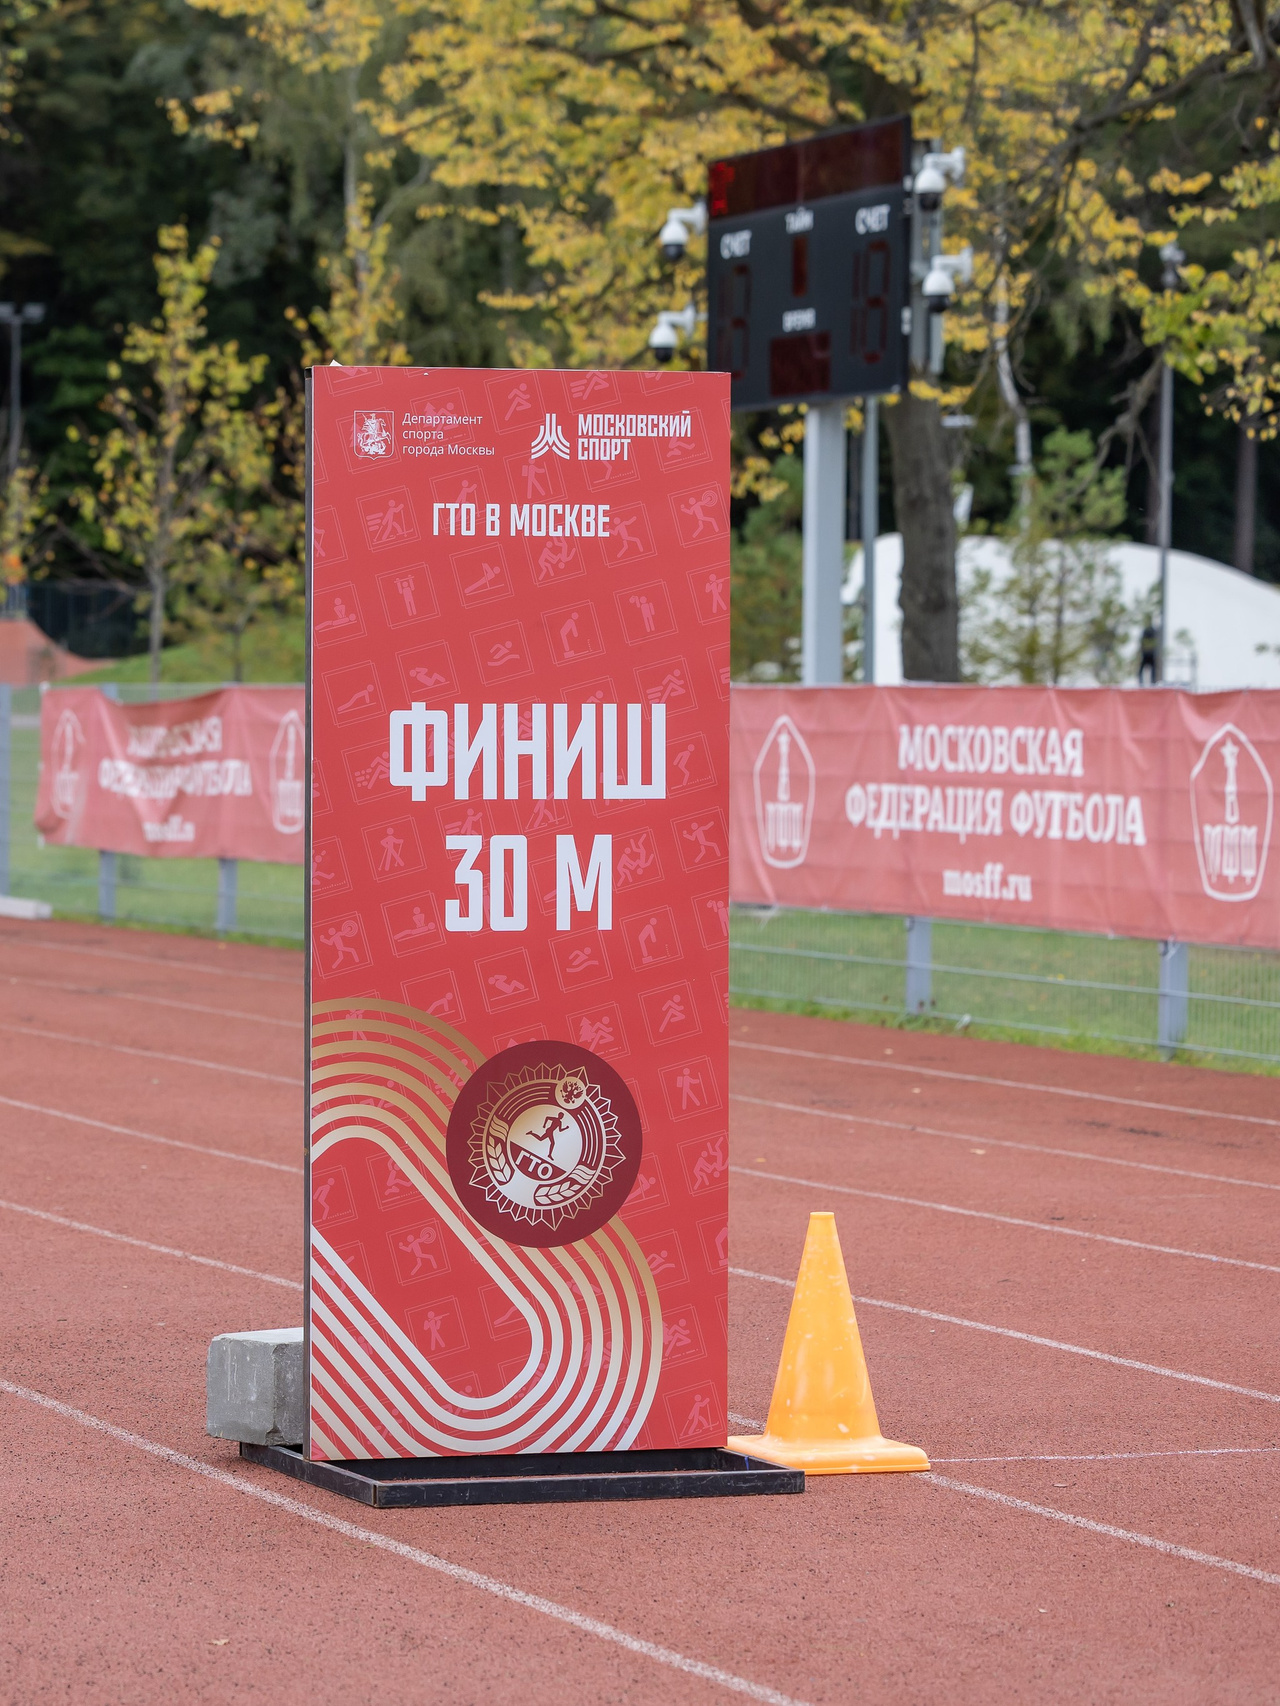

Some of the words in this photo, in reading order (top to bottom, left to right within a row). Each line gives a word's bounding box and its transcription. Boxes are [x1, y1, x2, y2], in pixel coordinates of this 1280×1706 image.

[402, 412, 483, 427] Департамент
[402, 429, 444, 442] спорта
[577, 411, 692, 437] МОСКОВСКИЙ
[402, 445, 444, 458] города
[447, 444, 495, 456] Москвы
[577, 438, 631, 461] СПОРТ
[433, 503, 477, 537] ГТО
[485, 503, 501, 537] В
[510, 503, 610, 537] МОСКВЕ
[389, 702, 666, 801] ФИНИШ
[898, 724, 1084, 777] МОСКОВСКАЯ
[845, 783, 1002, 844] ФЕДЕРАЦИЯ
[1010, 790, 1147, 846] ФУТБОЛА
[445, 834, 528, 932] 30
[556, 834, 612, 931] М
[943, 862, 1032, 901] mosff.ru
[515, 1150, 553, 1180] ГТО
